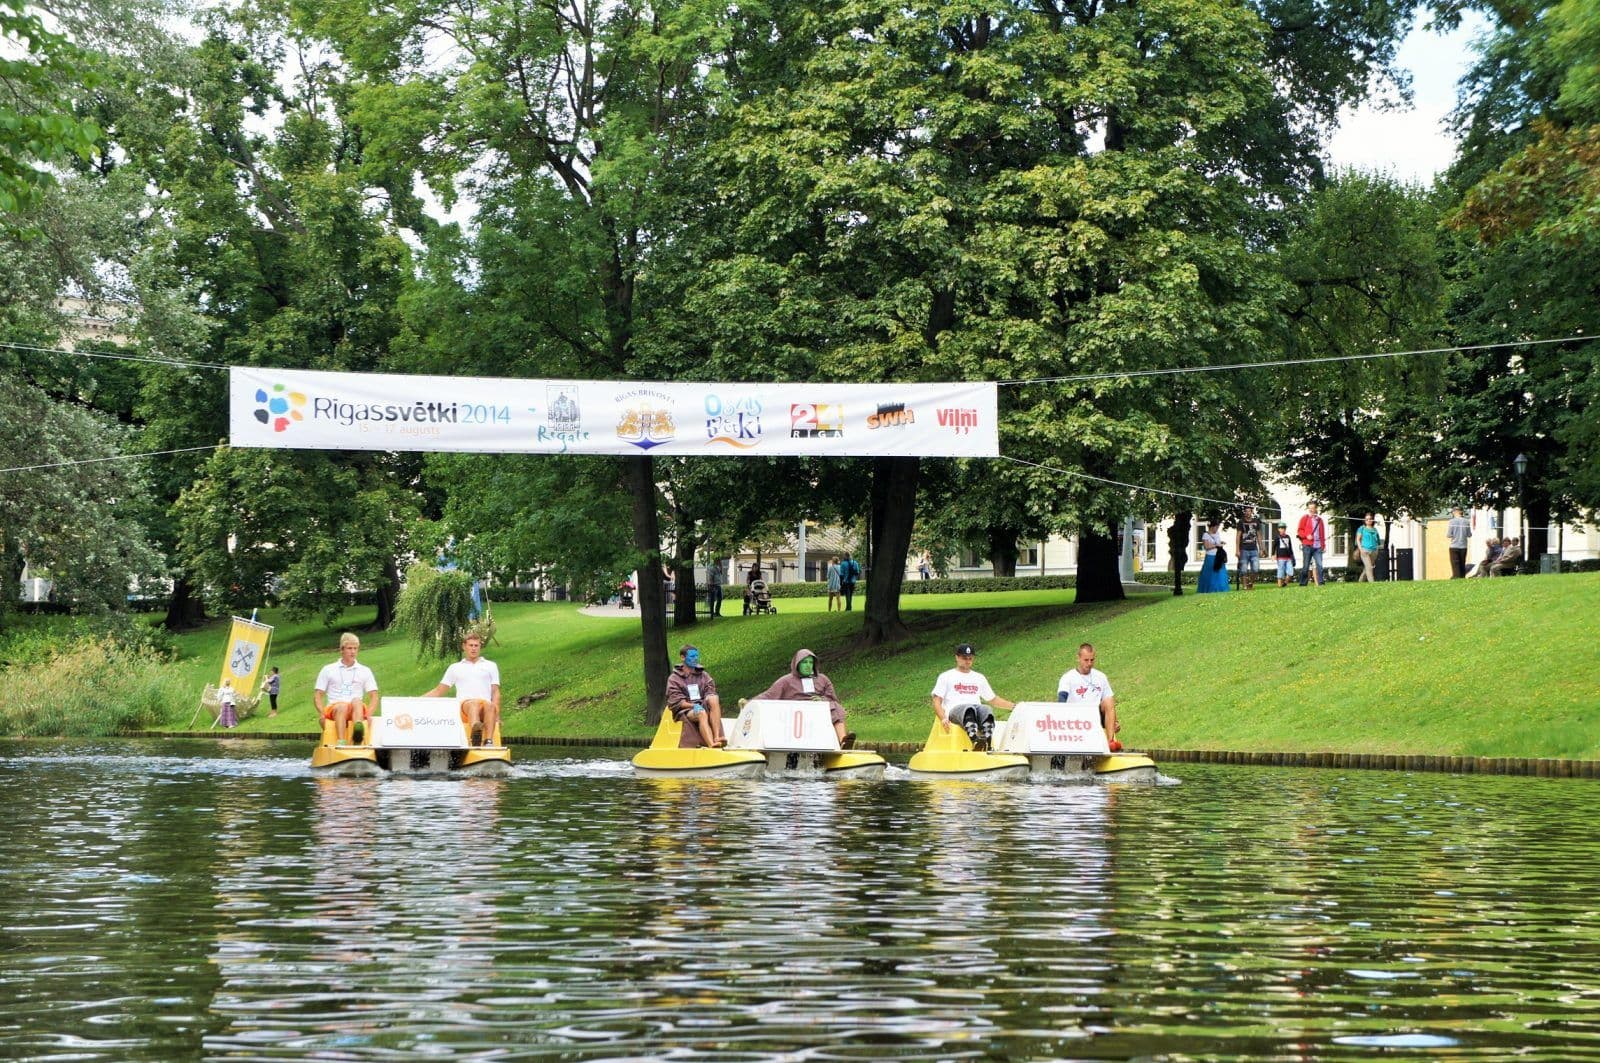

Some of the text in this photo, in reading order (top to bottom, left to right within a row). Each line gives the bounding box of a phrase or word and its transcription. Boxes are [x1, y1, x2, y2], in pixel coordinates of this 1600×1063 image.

[314, 397, 512, 426] Rīgassvētki 2014
[866, 409, 915, 430] SWH
[936, 408, 977, 434] Viļņi
[1036, 714, 1092, 732] ghetto
[1048, 732, 1085, 742] bmx
